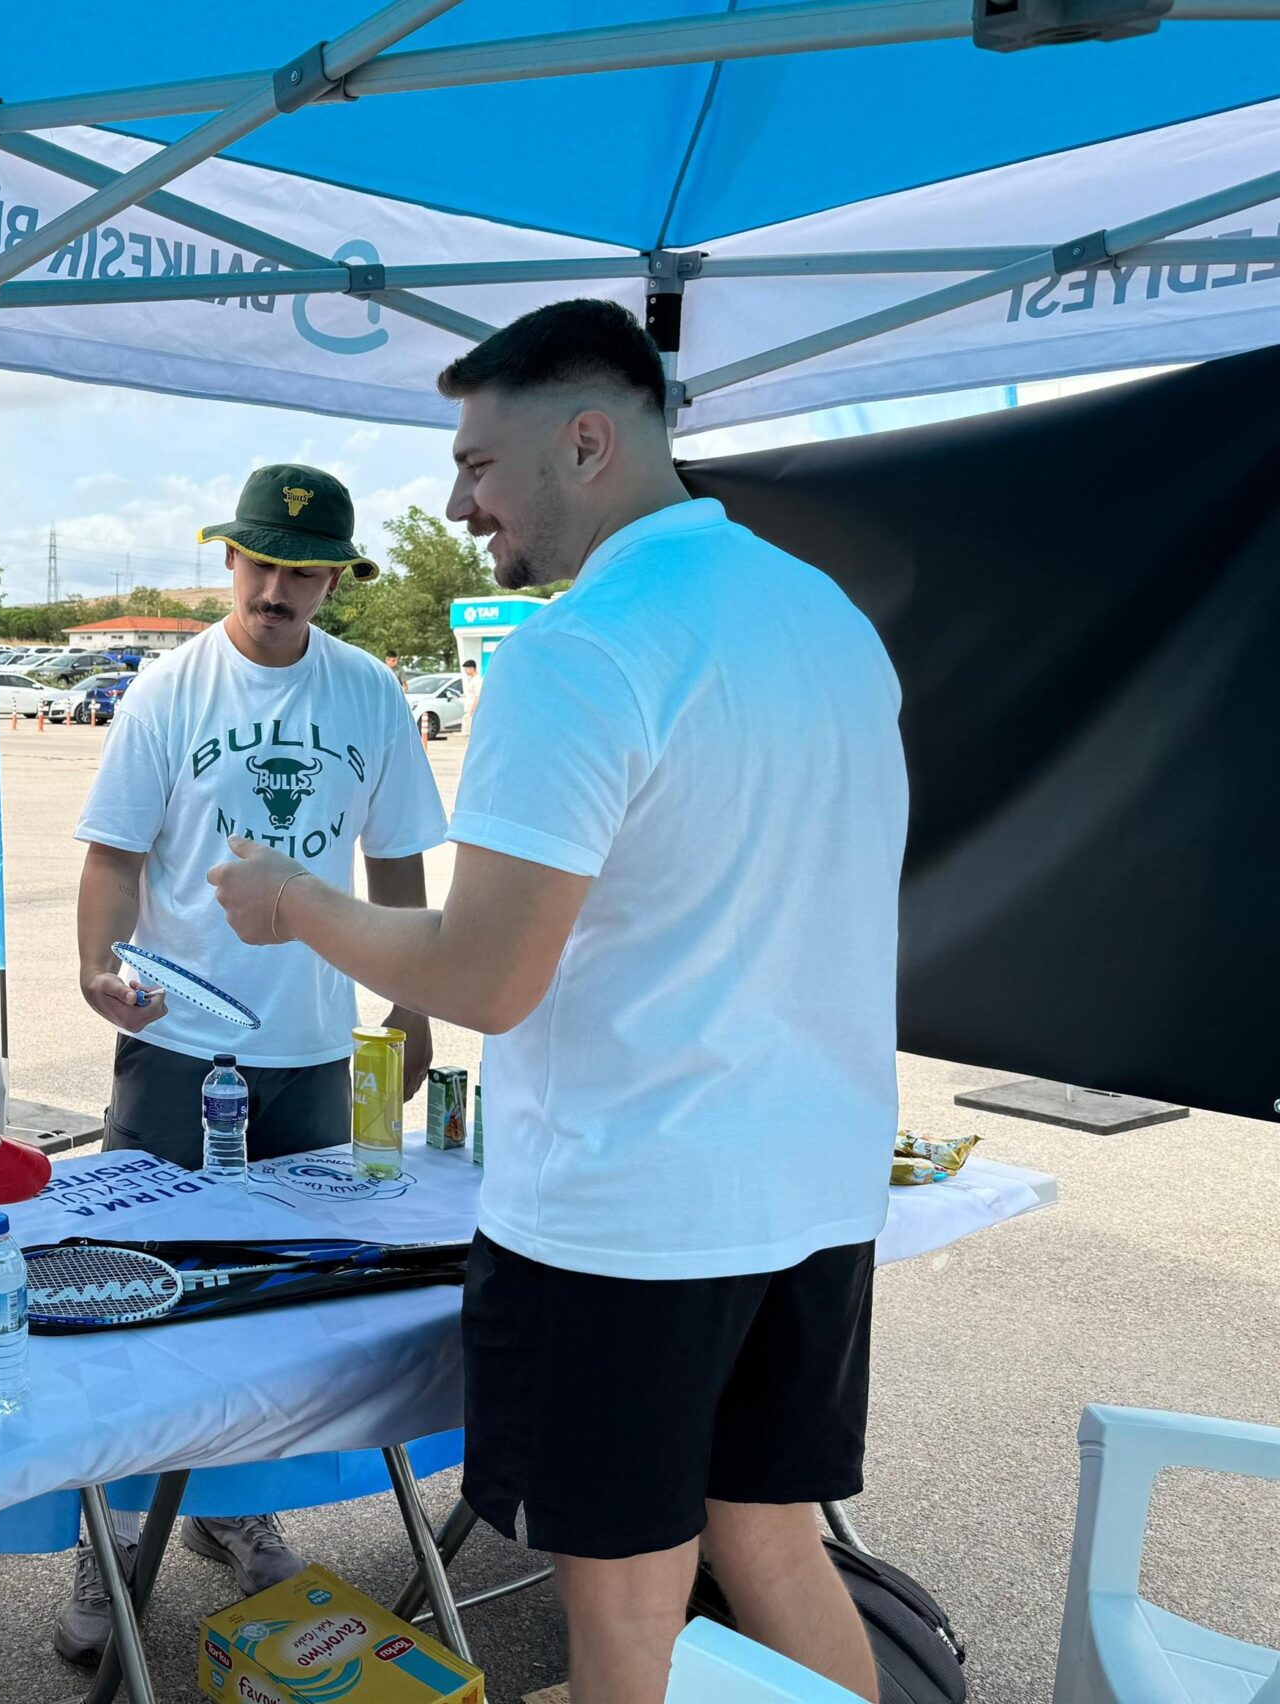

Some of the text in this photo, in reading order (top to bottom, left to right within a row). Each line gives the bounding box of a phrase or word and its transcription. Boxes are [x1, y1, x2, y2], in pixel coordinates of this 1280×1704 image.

[192, 719, 366, 784] BULLS
[258, 768, 313, 790] BULLS
[40, 1178, 143, 1206] EYLÜL
[206, 1643, 230, 1667] Torku
[380, 1639, 413, 1658] Torku
